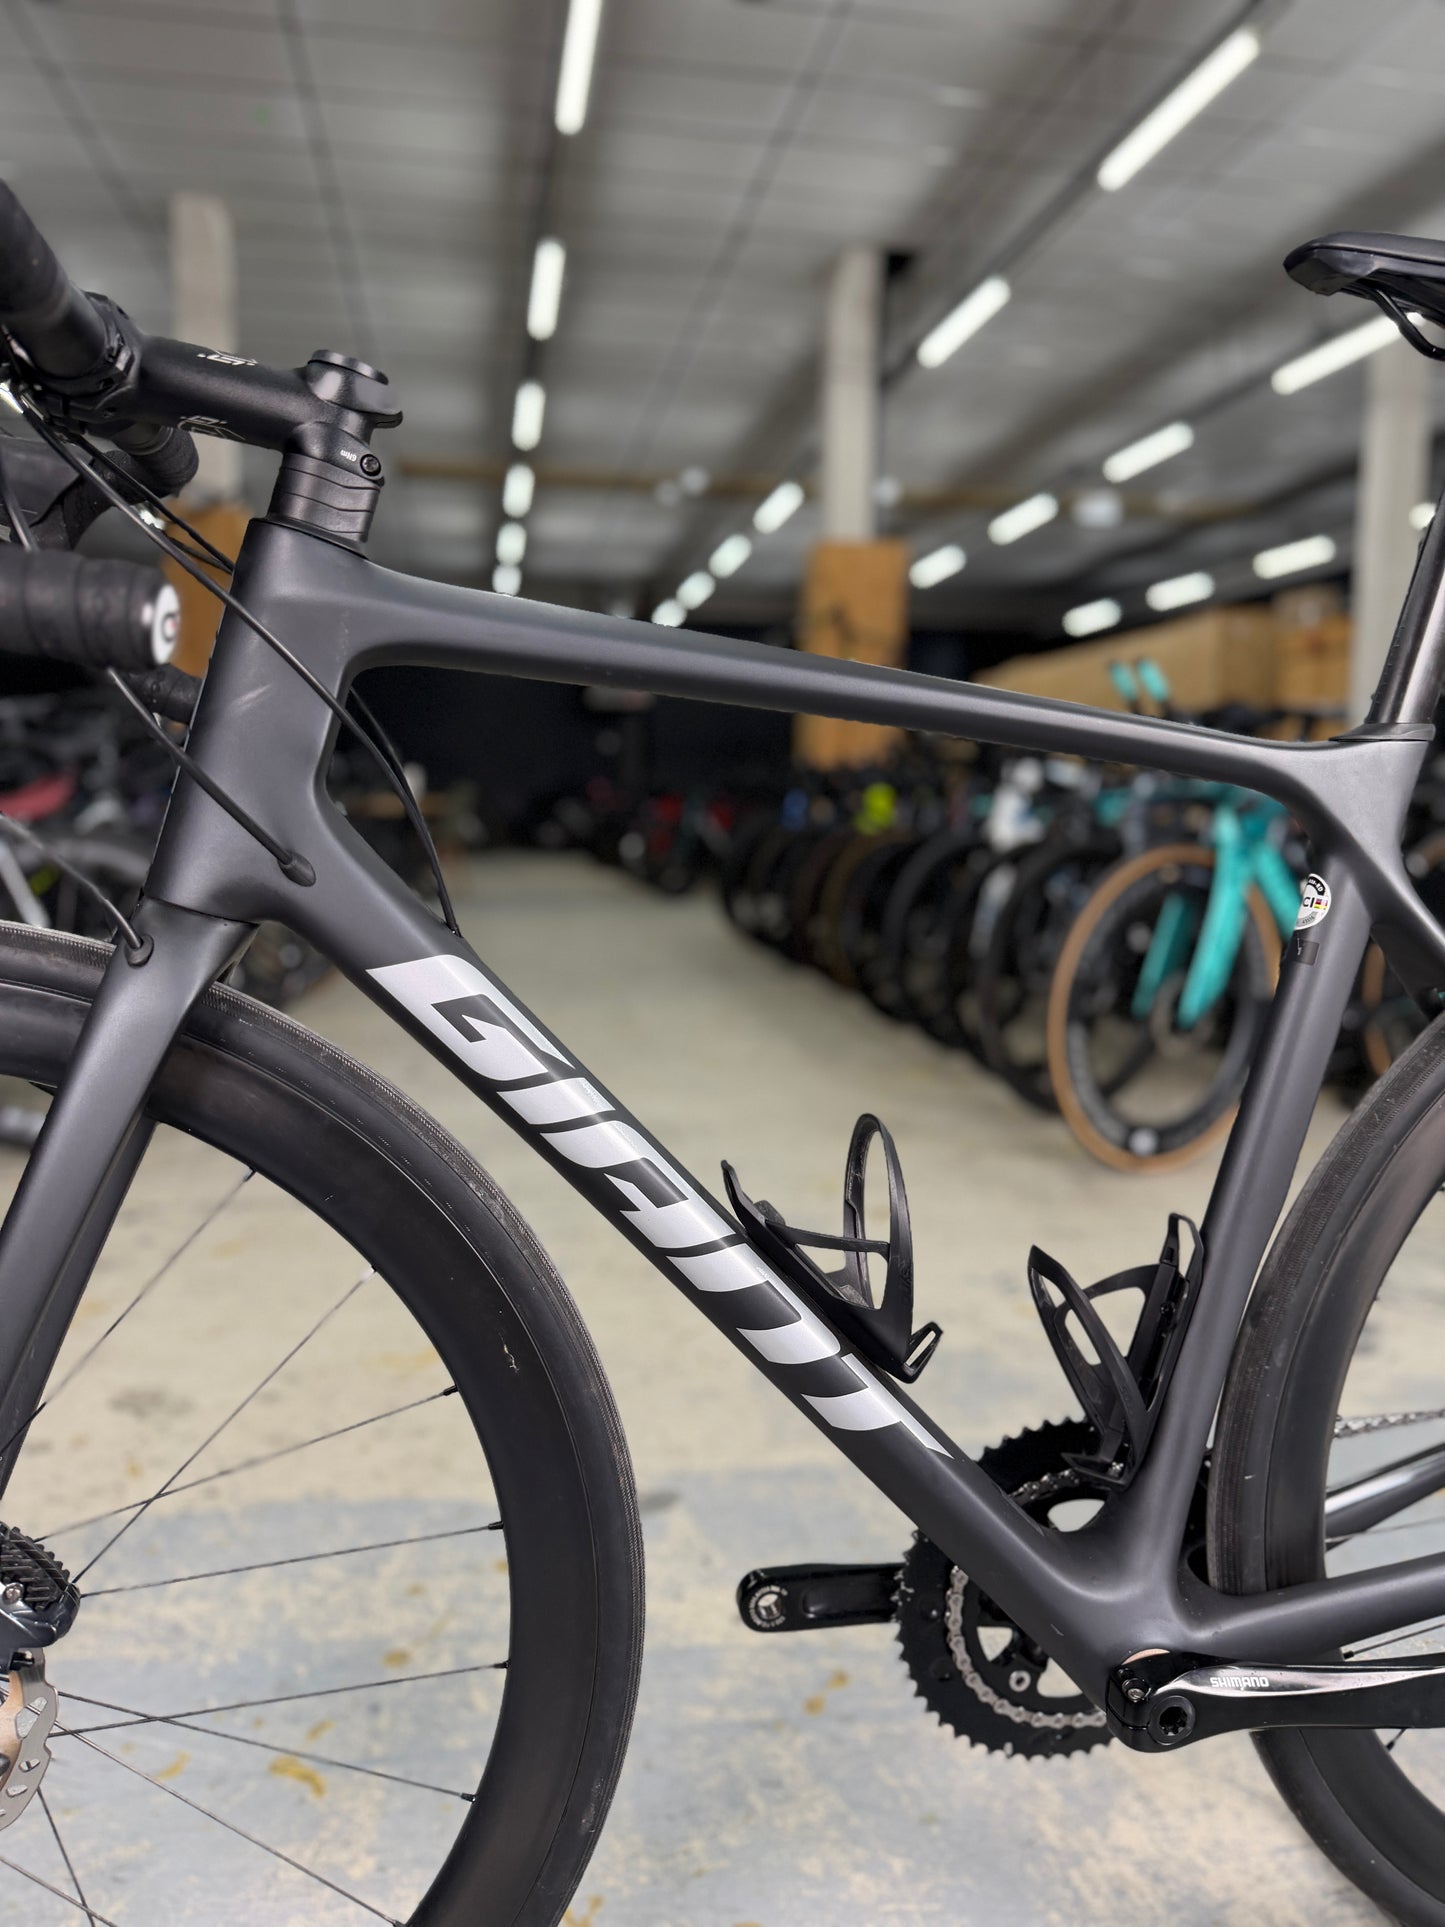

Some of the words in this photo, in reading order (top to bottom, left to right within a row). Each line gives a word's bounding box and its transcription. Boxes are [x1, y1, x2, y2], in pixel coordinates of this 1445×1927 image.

[1302, 896, 1315, 908] CI
[365, 954, 955, 1460] GIANT
[1210, 1676, 1270, 1688] SHIMANO
